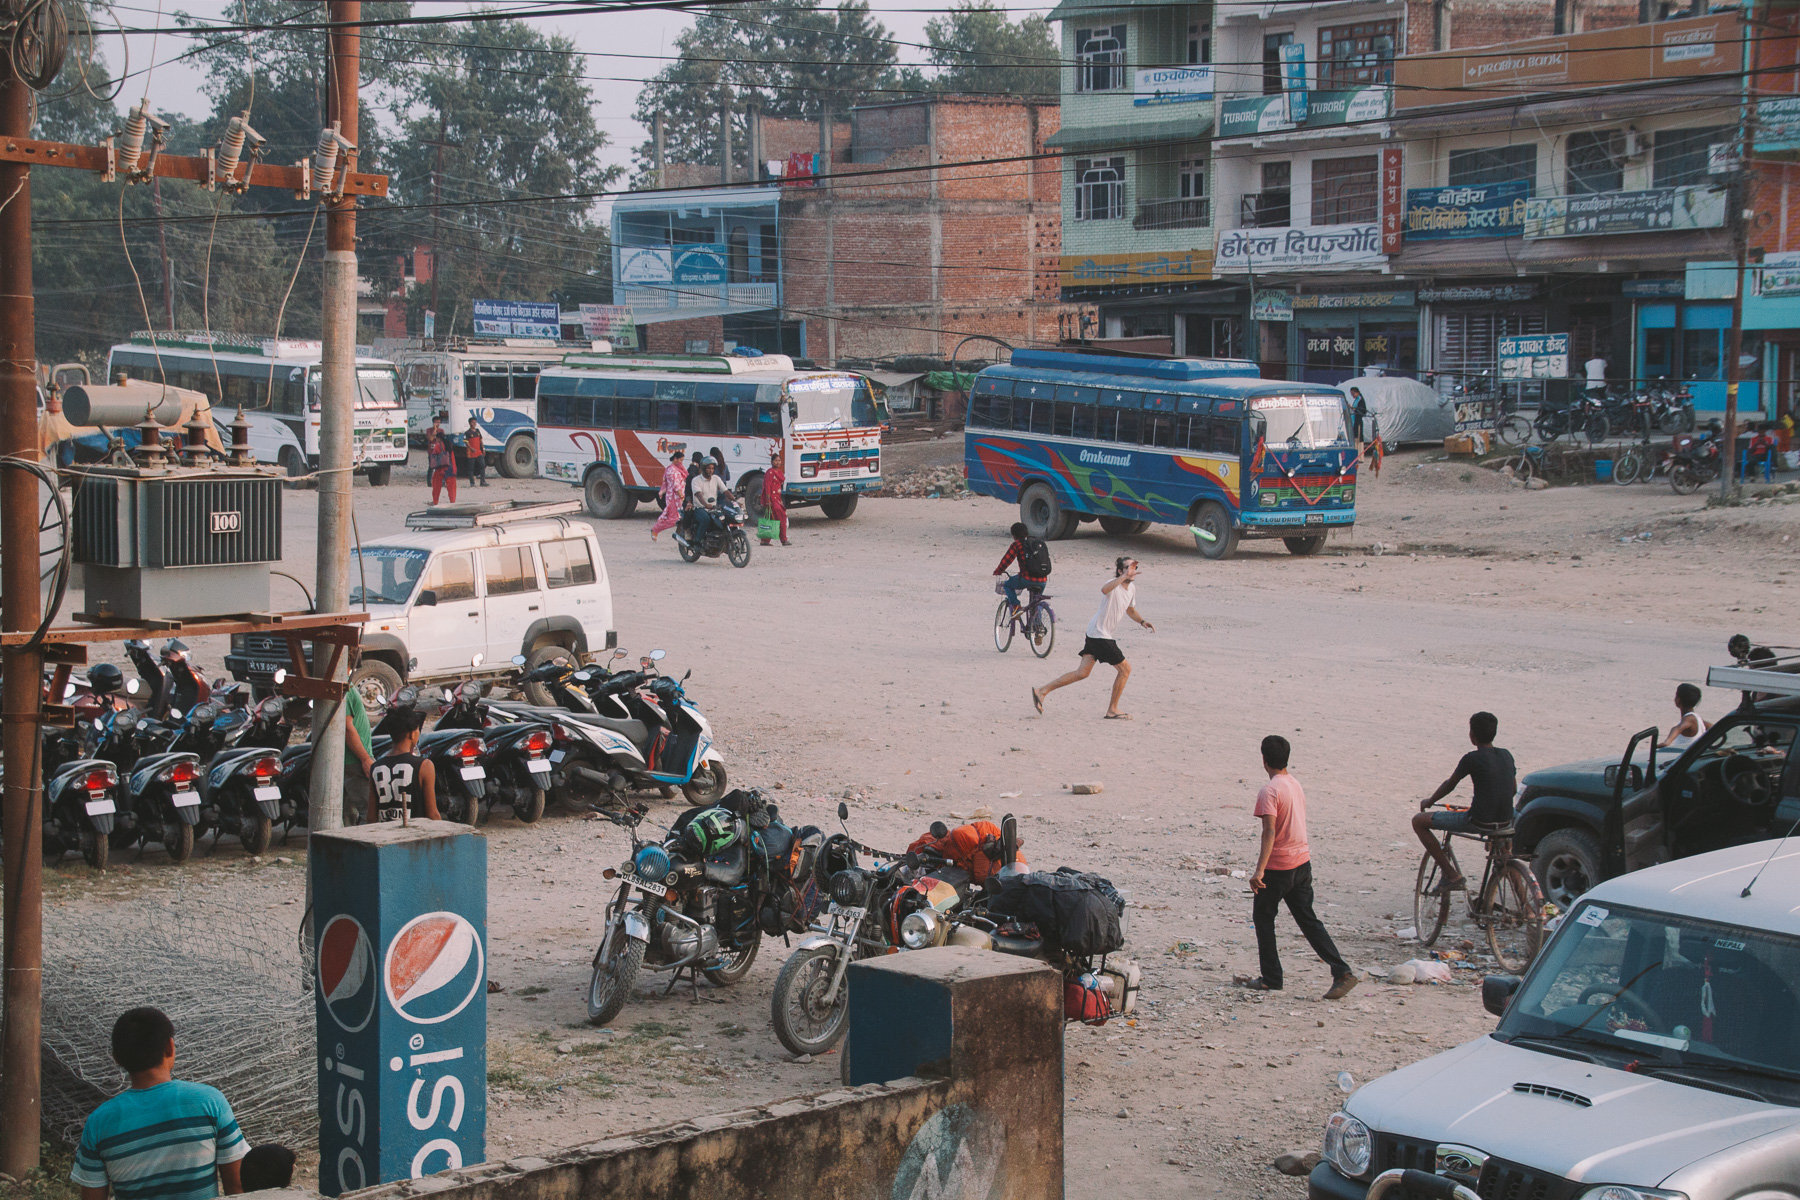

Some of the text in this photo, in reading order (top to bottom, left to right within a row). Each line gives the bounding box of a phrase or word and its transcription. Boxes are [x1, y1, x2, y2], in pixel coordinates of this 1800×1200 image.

[1310, 100, 1345, 114] TUBORG
[1223, 110, 1257, 125] TUBORG
[1220, 232, 1279, 259] होटल
[1079, 449, 1131, 467] Omkamal
[806, 485, 832, 494] SPEED
[214, 514, 238, 531] 100
[1259, 516, 1281, 524] SLOW
[385, 548, 423, 560] Surkhet
[372, 763, 414, 804] 82
[845, 909, 861, 918] 4363
[1716, 939, 1743, 950] NEPAL
